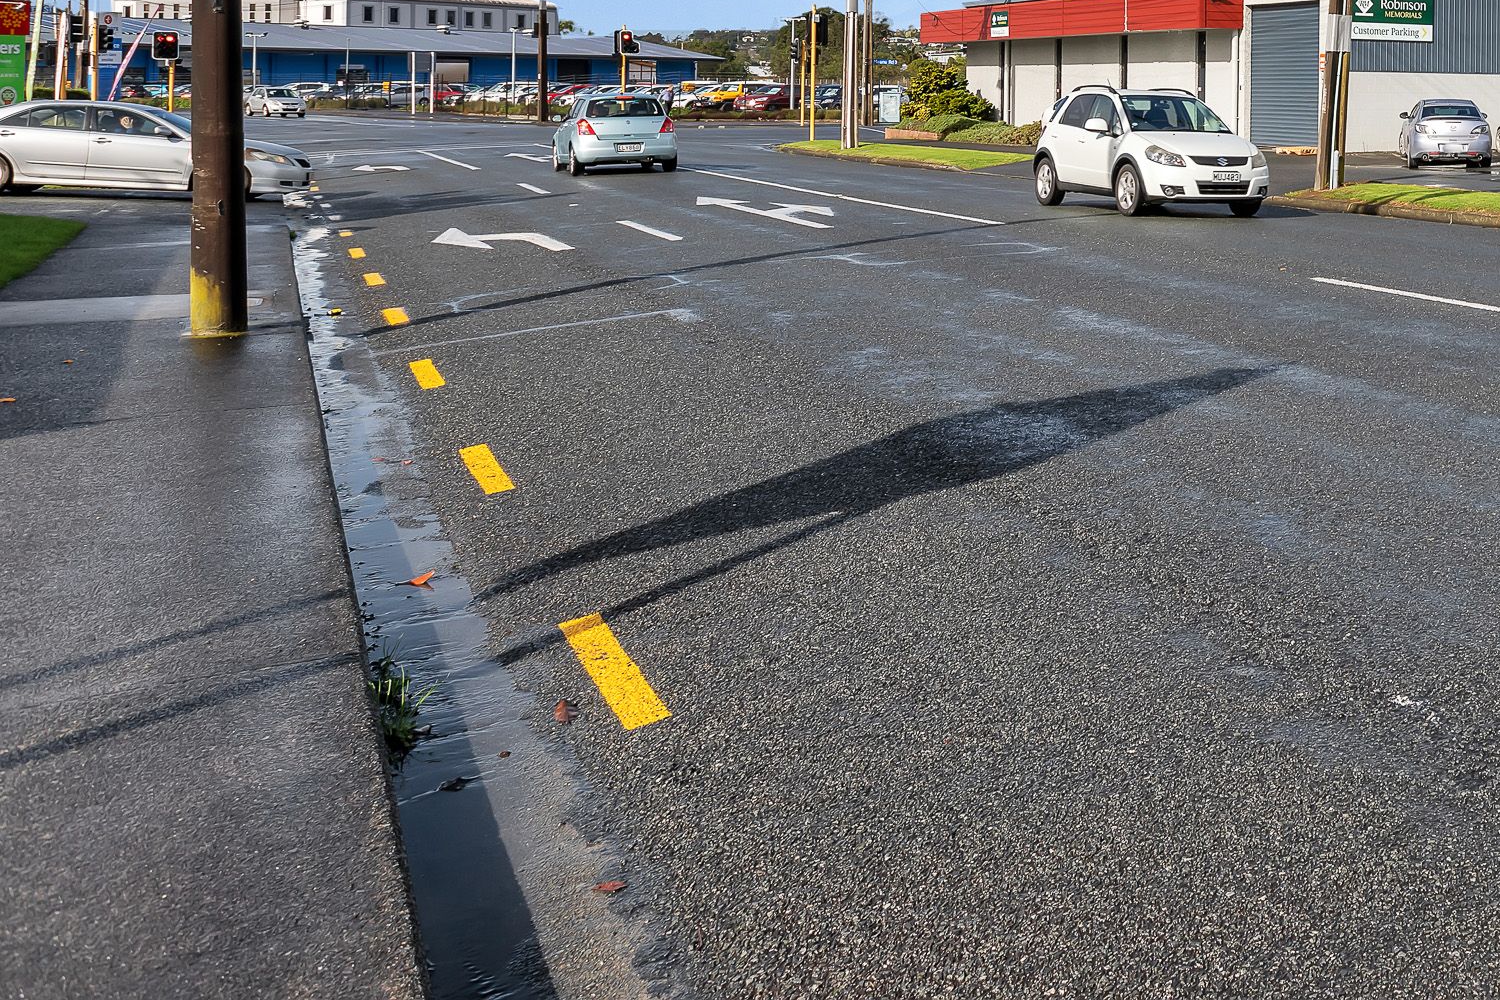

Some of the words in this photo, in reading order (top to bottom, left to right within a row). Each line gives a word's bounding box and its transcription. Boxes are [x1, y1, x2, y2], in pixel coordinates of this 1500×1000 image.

[1384, 11, 1422, 19] MEMORIALS
[1353, 26, 1389, 36] Customer
[1391, 27, 1420, 39] Parking
